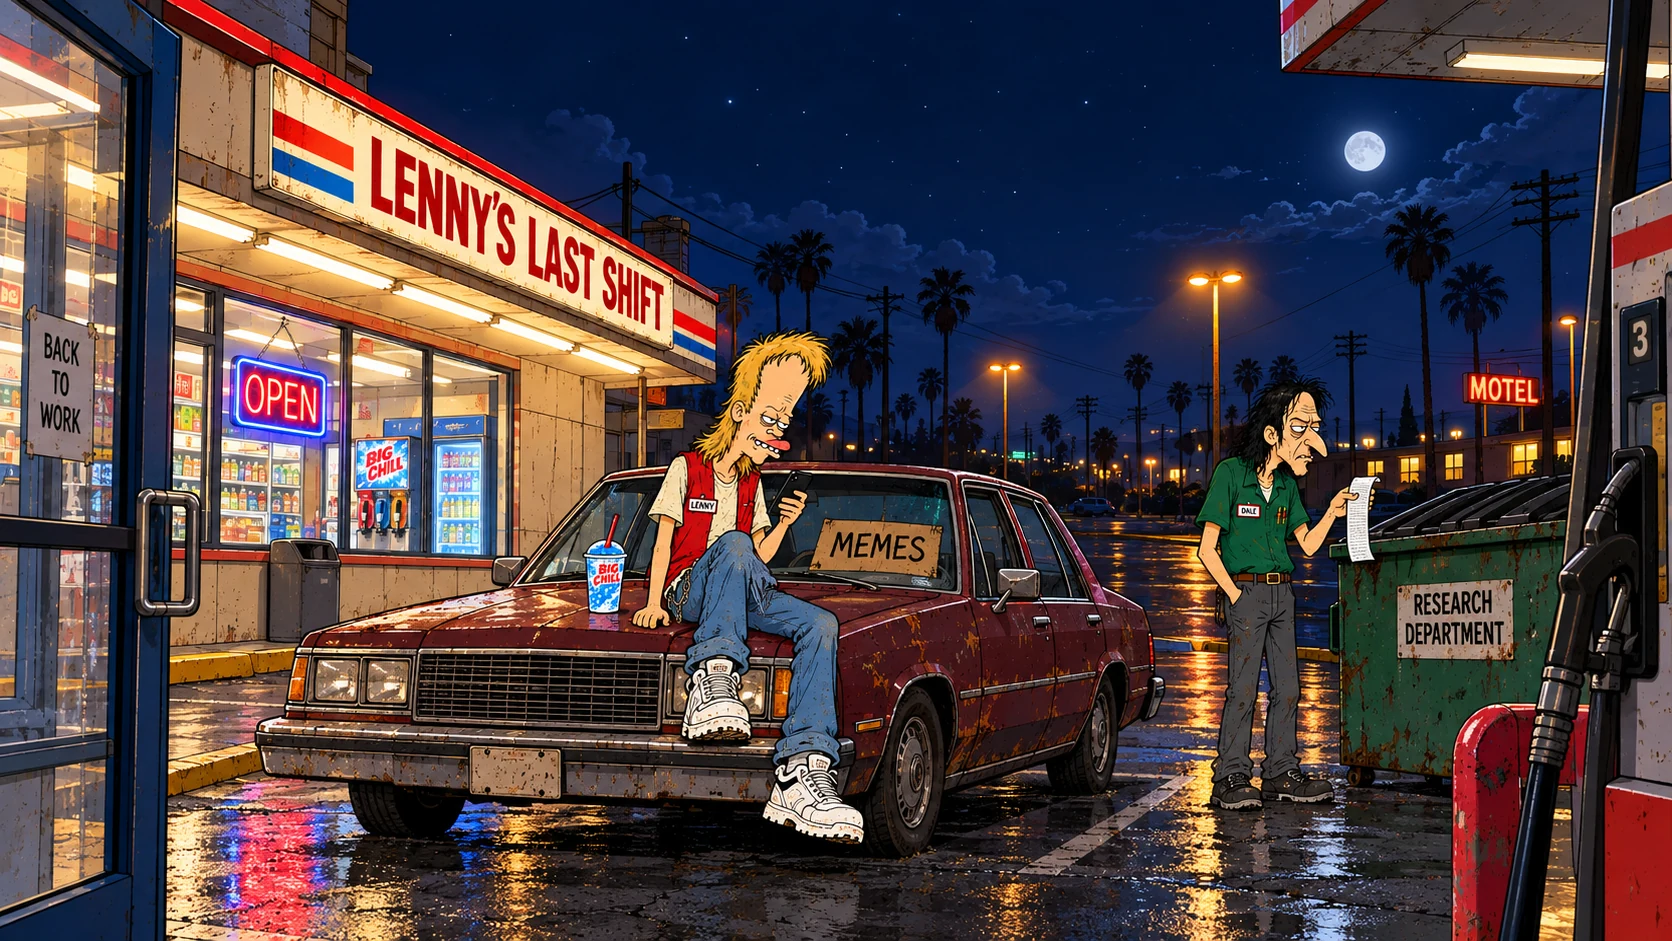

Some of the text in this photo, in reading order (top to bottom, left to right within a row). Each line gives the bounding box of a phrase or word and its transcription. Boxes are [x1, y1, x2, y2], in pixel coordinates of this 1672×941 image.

[370, 135, 664, 331] LENNY'S LAST SHIFT
[44, 332, 80, 367] BACK
[1632, 319, 1648, 358] 3
[51, 369, 69, 397] TO
[1470, 375, 1539, 404] MOTEL
[244, 373, 317, 424] OPEN
[40, 401, 81, 434] WORK
[365, 445, 393, 468] BIG
[367, 457, 403, 483] CHILL
[690, 500, 715, 511] LENNY
[1241, 507, 1257, 515] DALE
[829, 531, 925, 563] MEMES
[593, 572, 621, 587] CHILL
[598, 563, 619, 575] BIG
[1413, 589, 1492, 616] RESEARCH
[1405, 620, 1505, 647] DEPARTMENT
